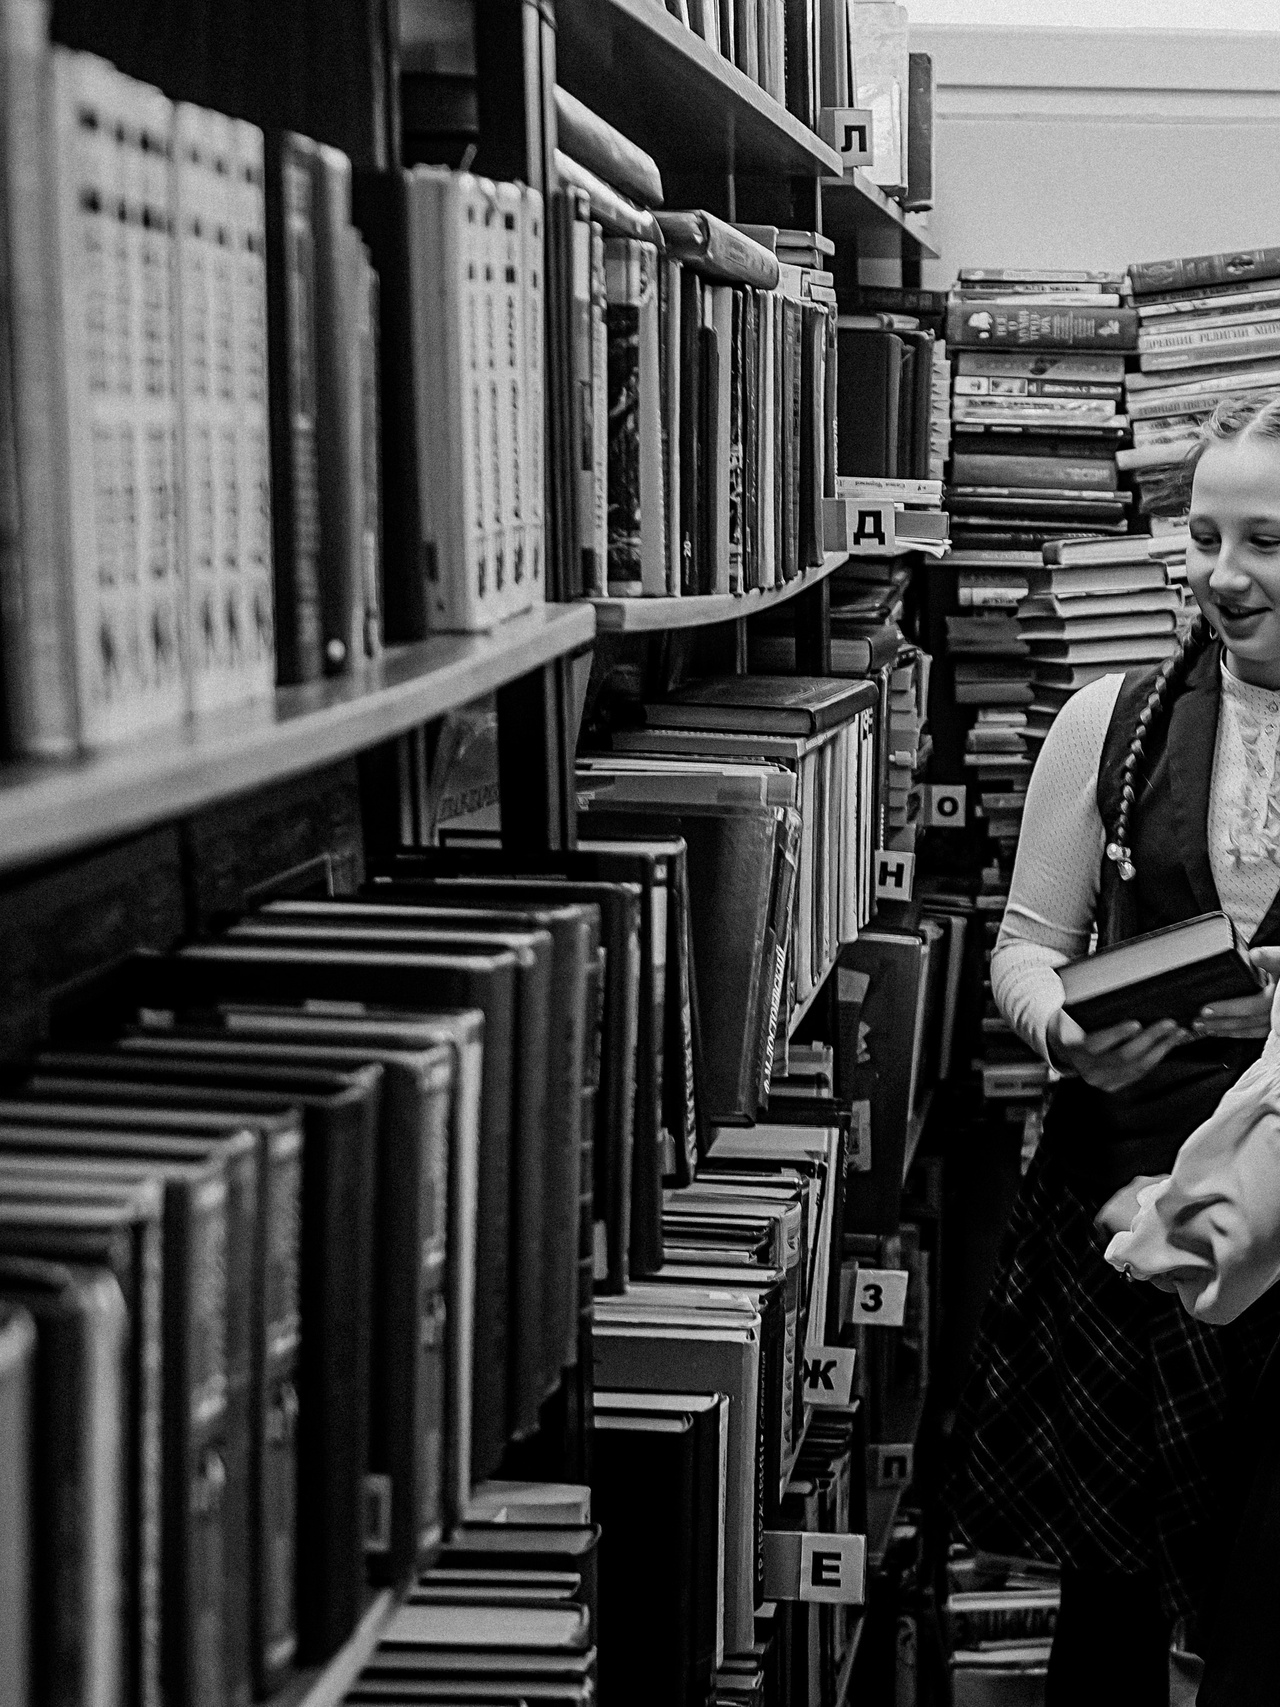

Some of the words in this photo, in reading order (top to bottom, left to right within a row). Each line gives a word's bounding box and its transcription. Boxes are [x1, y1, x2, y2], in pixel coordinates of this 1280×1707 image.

[841, 125, 867, 152] Л
[853, 510, 886, 545] Д
[937, 796, 959, 817] О
[878, 861, 904, 888] Н
[811, 1551, 842, 1587] Е
